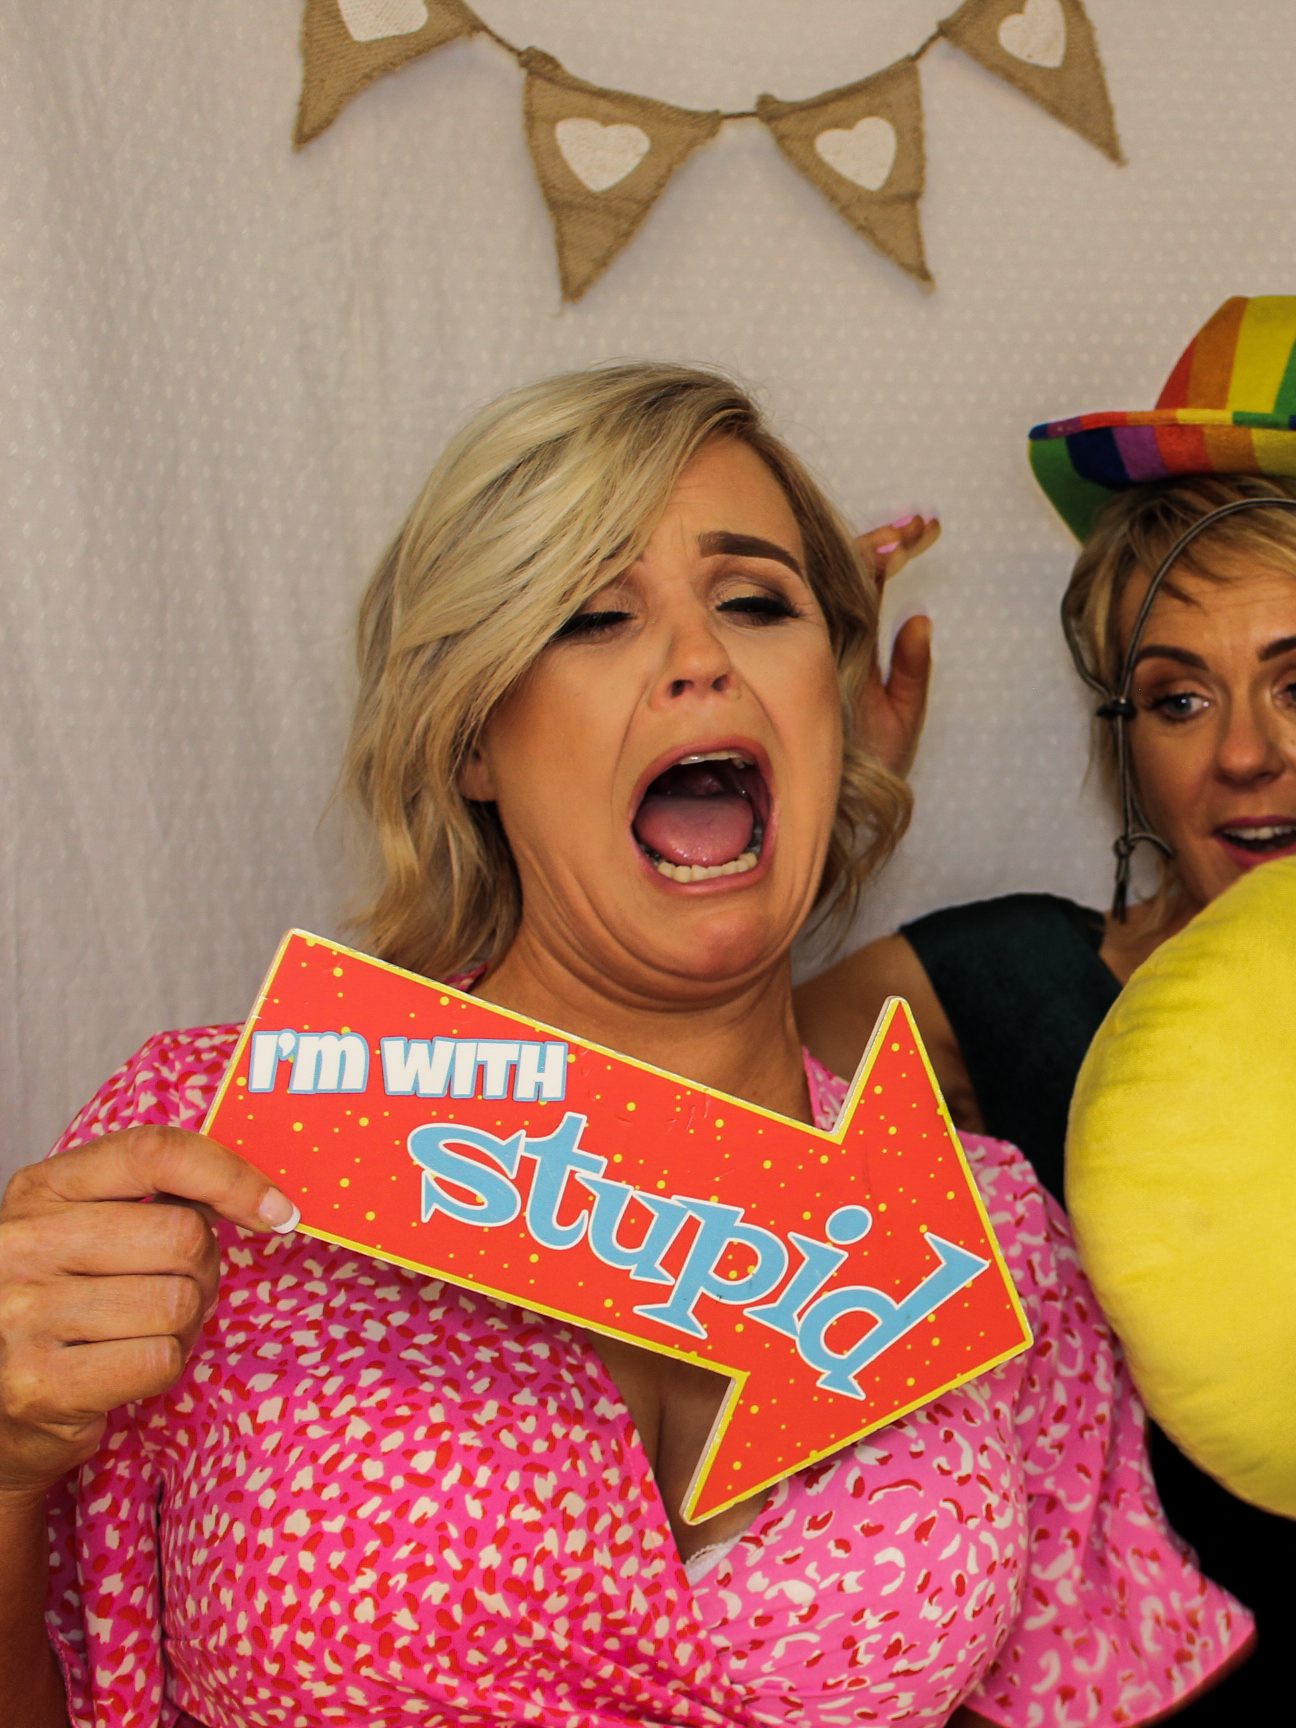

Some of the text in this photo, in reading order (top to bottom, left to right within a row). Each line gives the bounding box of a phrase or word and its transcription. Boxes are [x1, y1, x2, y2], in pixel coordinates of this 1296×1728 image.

[248, 1031, 568, 1102] I'm WITH
[408, 1113, 989, 1399] stupid
